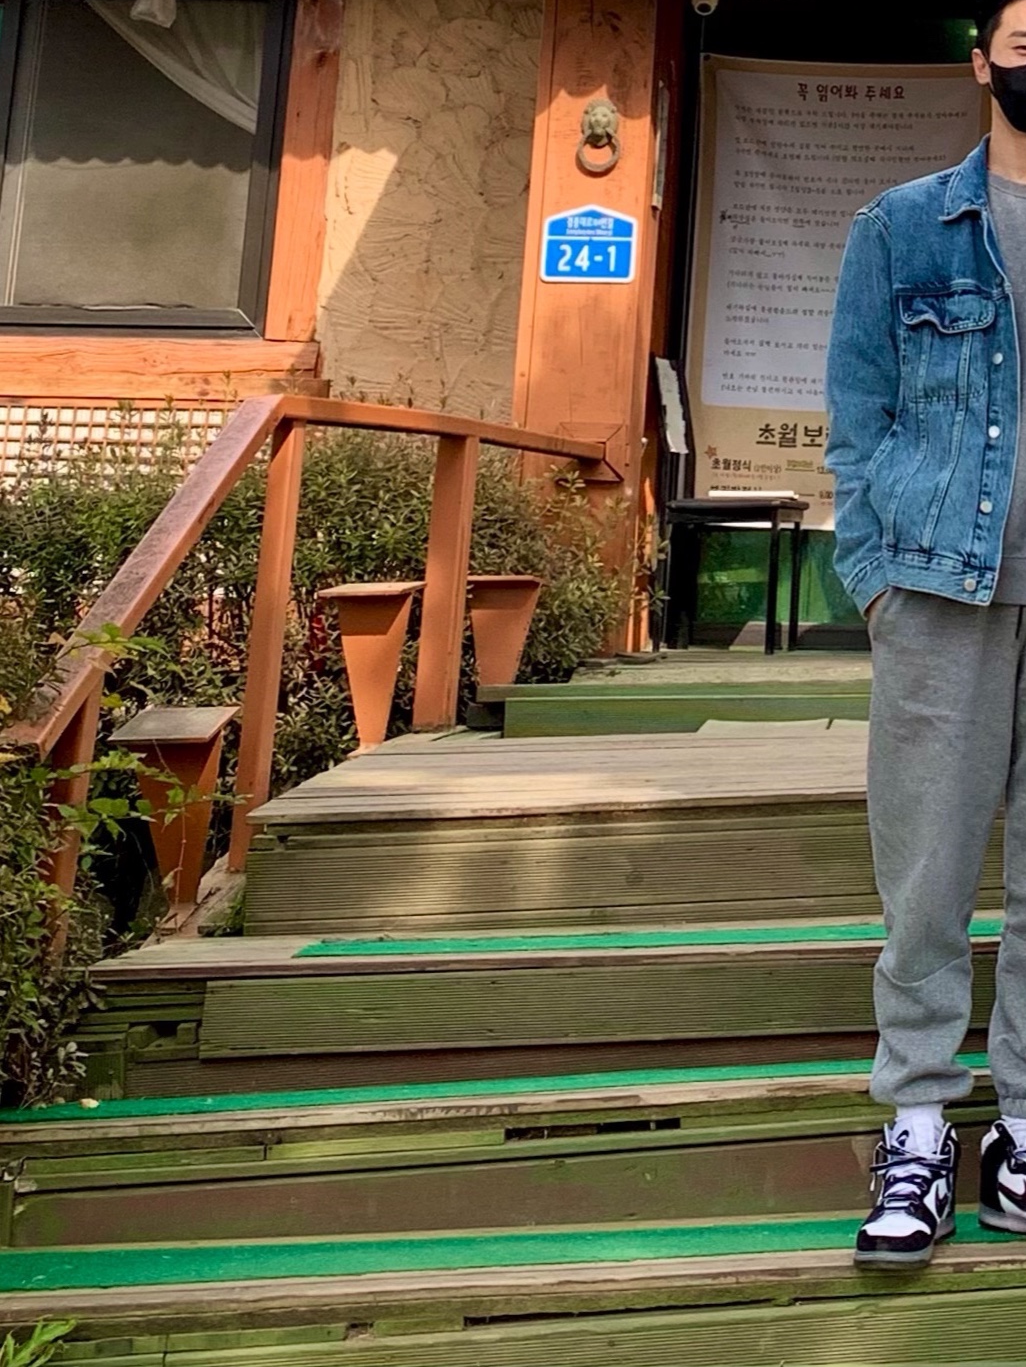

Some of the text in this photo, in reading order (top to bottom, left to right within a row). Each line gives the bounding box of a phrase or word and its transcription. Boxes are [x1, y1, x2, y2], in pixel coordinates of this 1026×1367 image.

[797, 82, 809, 102] 꼭
[864, 84, 905, 102] 주세요
[557, 244, 617, 272] 24-1
[711, 458, 752, 473] 초월정식
